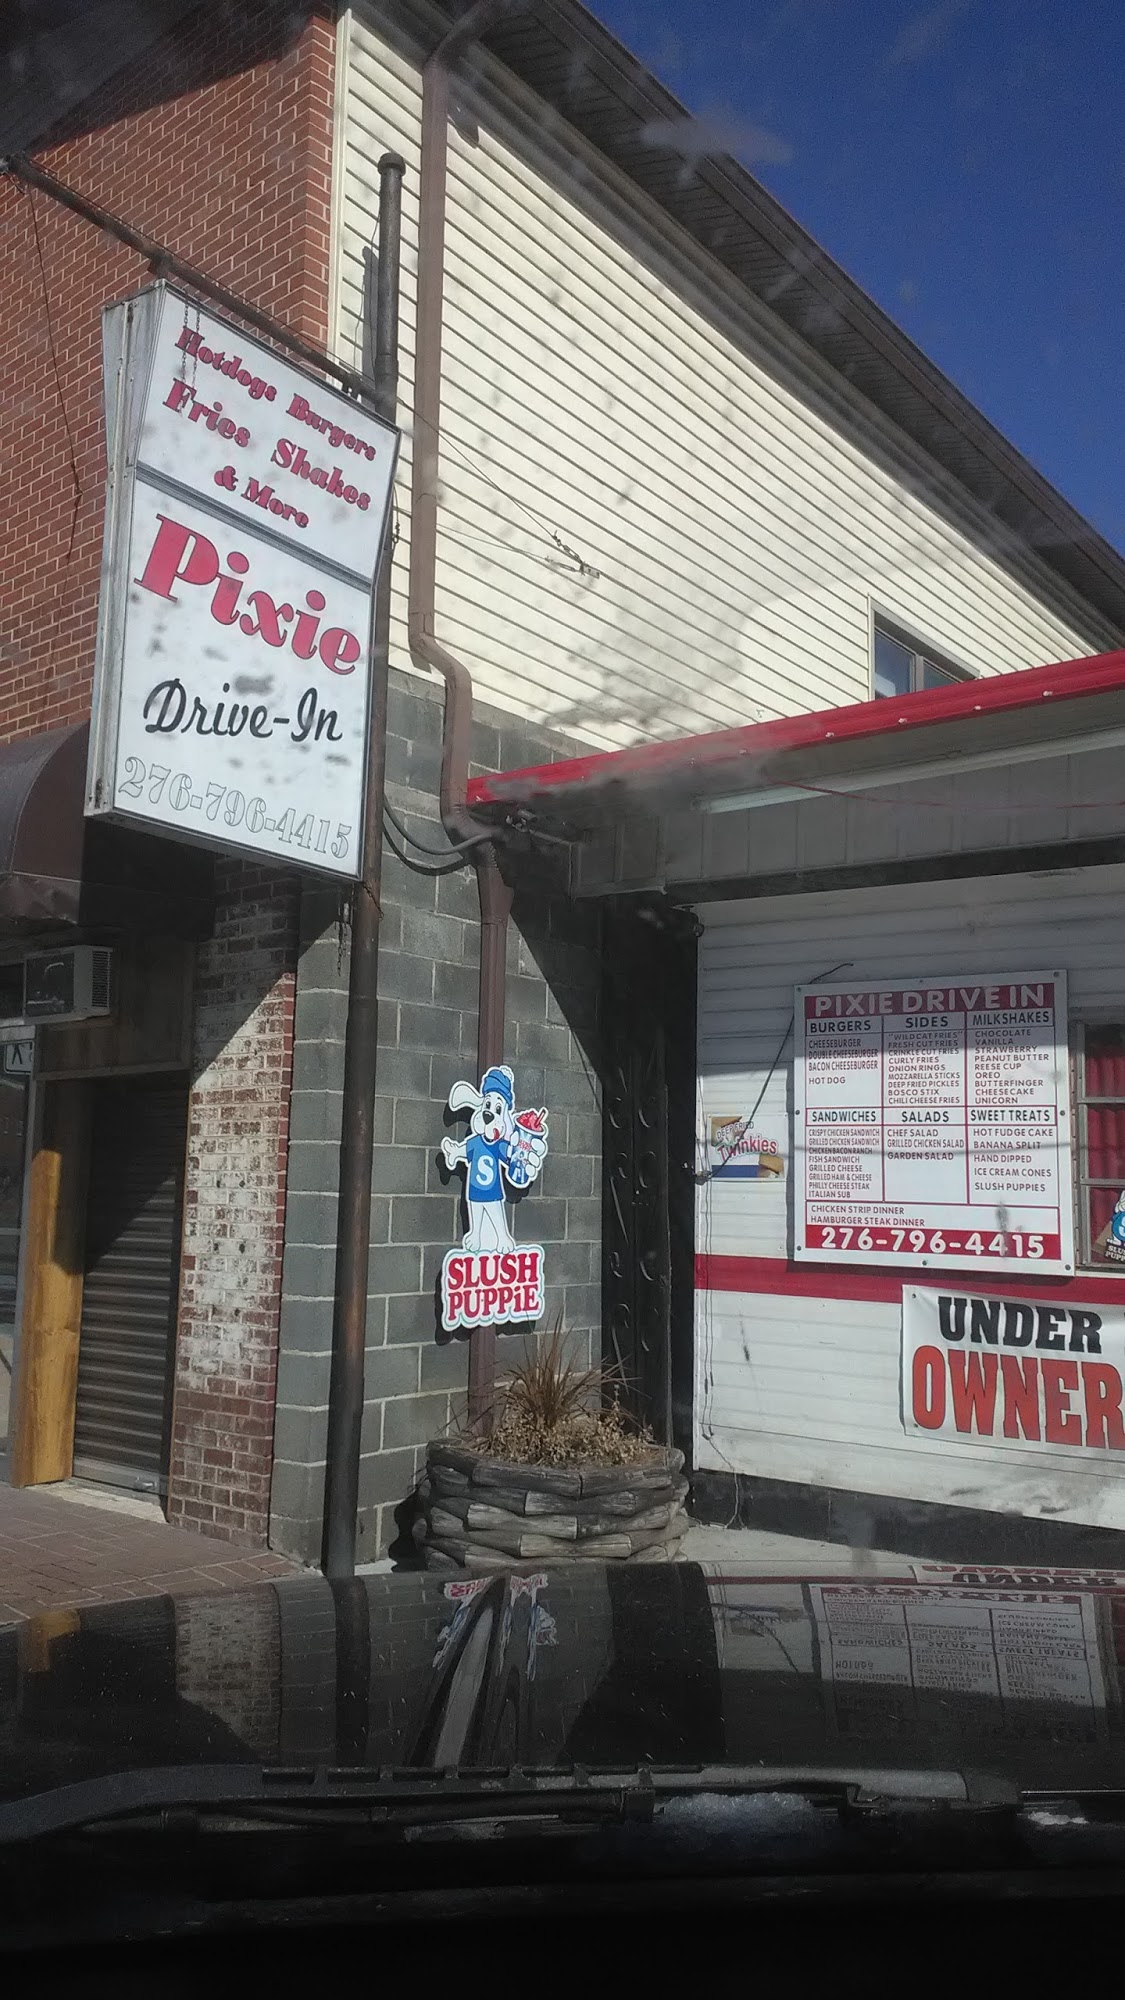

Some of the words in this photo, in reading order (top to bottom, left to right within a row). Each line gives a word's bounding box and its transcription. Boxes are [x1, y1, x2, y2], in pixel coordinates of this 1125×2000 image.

[175, 326, 277, 401] Hotdogs
[286, 393, 376, 461] Burgers
[163, 378, 250, 447] Fries
[270, 438, 371, 511] Shakes
[214, 466, 238, 491] &
[241, 477, 309, 528] More
[134, 513, 361, 675] Pixie
[143, 678, 342, 742] Drive-In
[118, 756, 352, 858] 276-796-4415
[815, 993, 893, 1017] PIXIE
[902, 987, 1000, 1012] DRIVE
[1010, 985, 1044, 1008] IN
[906, 1016, 948, 1028] SIDES
[973, 1011, 1049, 1025] MILKSHAKES
[810, 1020, 871, 1033] BURGERS
[975, 1029, 1031, 1037] CHOCOLATE
[809, 1039, 861, 1048] CHEESEBURGER
[916, 1040, 932, 1048] CUT
[809, 1050, 832, 1059] DOUBLE
[833, 1049, 878, 1058] CHEESEBURGER
[922, 1048, 937, 1056] CUT
[917, 1056, 939, 1064] FRIES
[975, 1054, 1010, 1062] PEANUT
[809, 1061, 831, 1071] BACON
[832, 1060, 878, 1070] CHEESEBURGER
[888, 1072, 932, 1080] MOZZARELLA
[975, 1088, 1034, 1096] CHEESECAKE
[812, 1111, 876, 1122] SANDWICHES
[902, 1111, 950, 1122] SALADS
[970, 1110, 1005, 1121] SWEET
[1009, 1110, 1050, 1121] TREATS
[809, 1138, 828, 1146] GRILLED
[829, 1138, 850, 1146] CHICKEN
[852, 1138, 880, 1146] SANDWICH
[888, 1139, 912, 1148] GRILLED
[914, 1139, 941, 1148] CHICKEN
[942, 1139, 964, 1148] SALAD
[717, 1135, 777, 1161] Twinkies
[888, 1152, 922, 1160] GARDEN
[925, 1152, 954, 1160] SALAD
[1001, 1155, 1032, 1163] DIPPED
[476, 1155, 495, 1186] S
[809, 1164, 836, 1172] GRILLED
[974, 1168, 987, 1176] ICE
[989, 1168, 1020, 1176] CREAM
[1022, 1168, 1052, 1177] CONES
[974, 1182, 1004, 1190] SLUSH
[1006, 1183, 1046, 1192] PUPPIES
[811, 1205, 846, 1214] CHICKEN
[848, 1206, 872, 1214] STRIP
[873, 1206, 904, 1214] DINNER
[811, 1216, 862, 1225] HAMBURGER
[864, 1217, 890, 1226] STEAK
[893, 1218, 925, 1226] DINNER
[821, 1227, 1044, 1258] 276-796-4415
[448, 1252, 538, 1290] SLUSH
[938, 1296, 1102, 1354] UNDER
[912, 1345, 1125, 1450] OWNER
